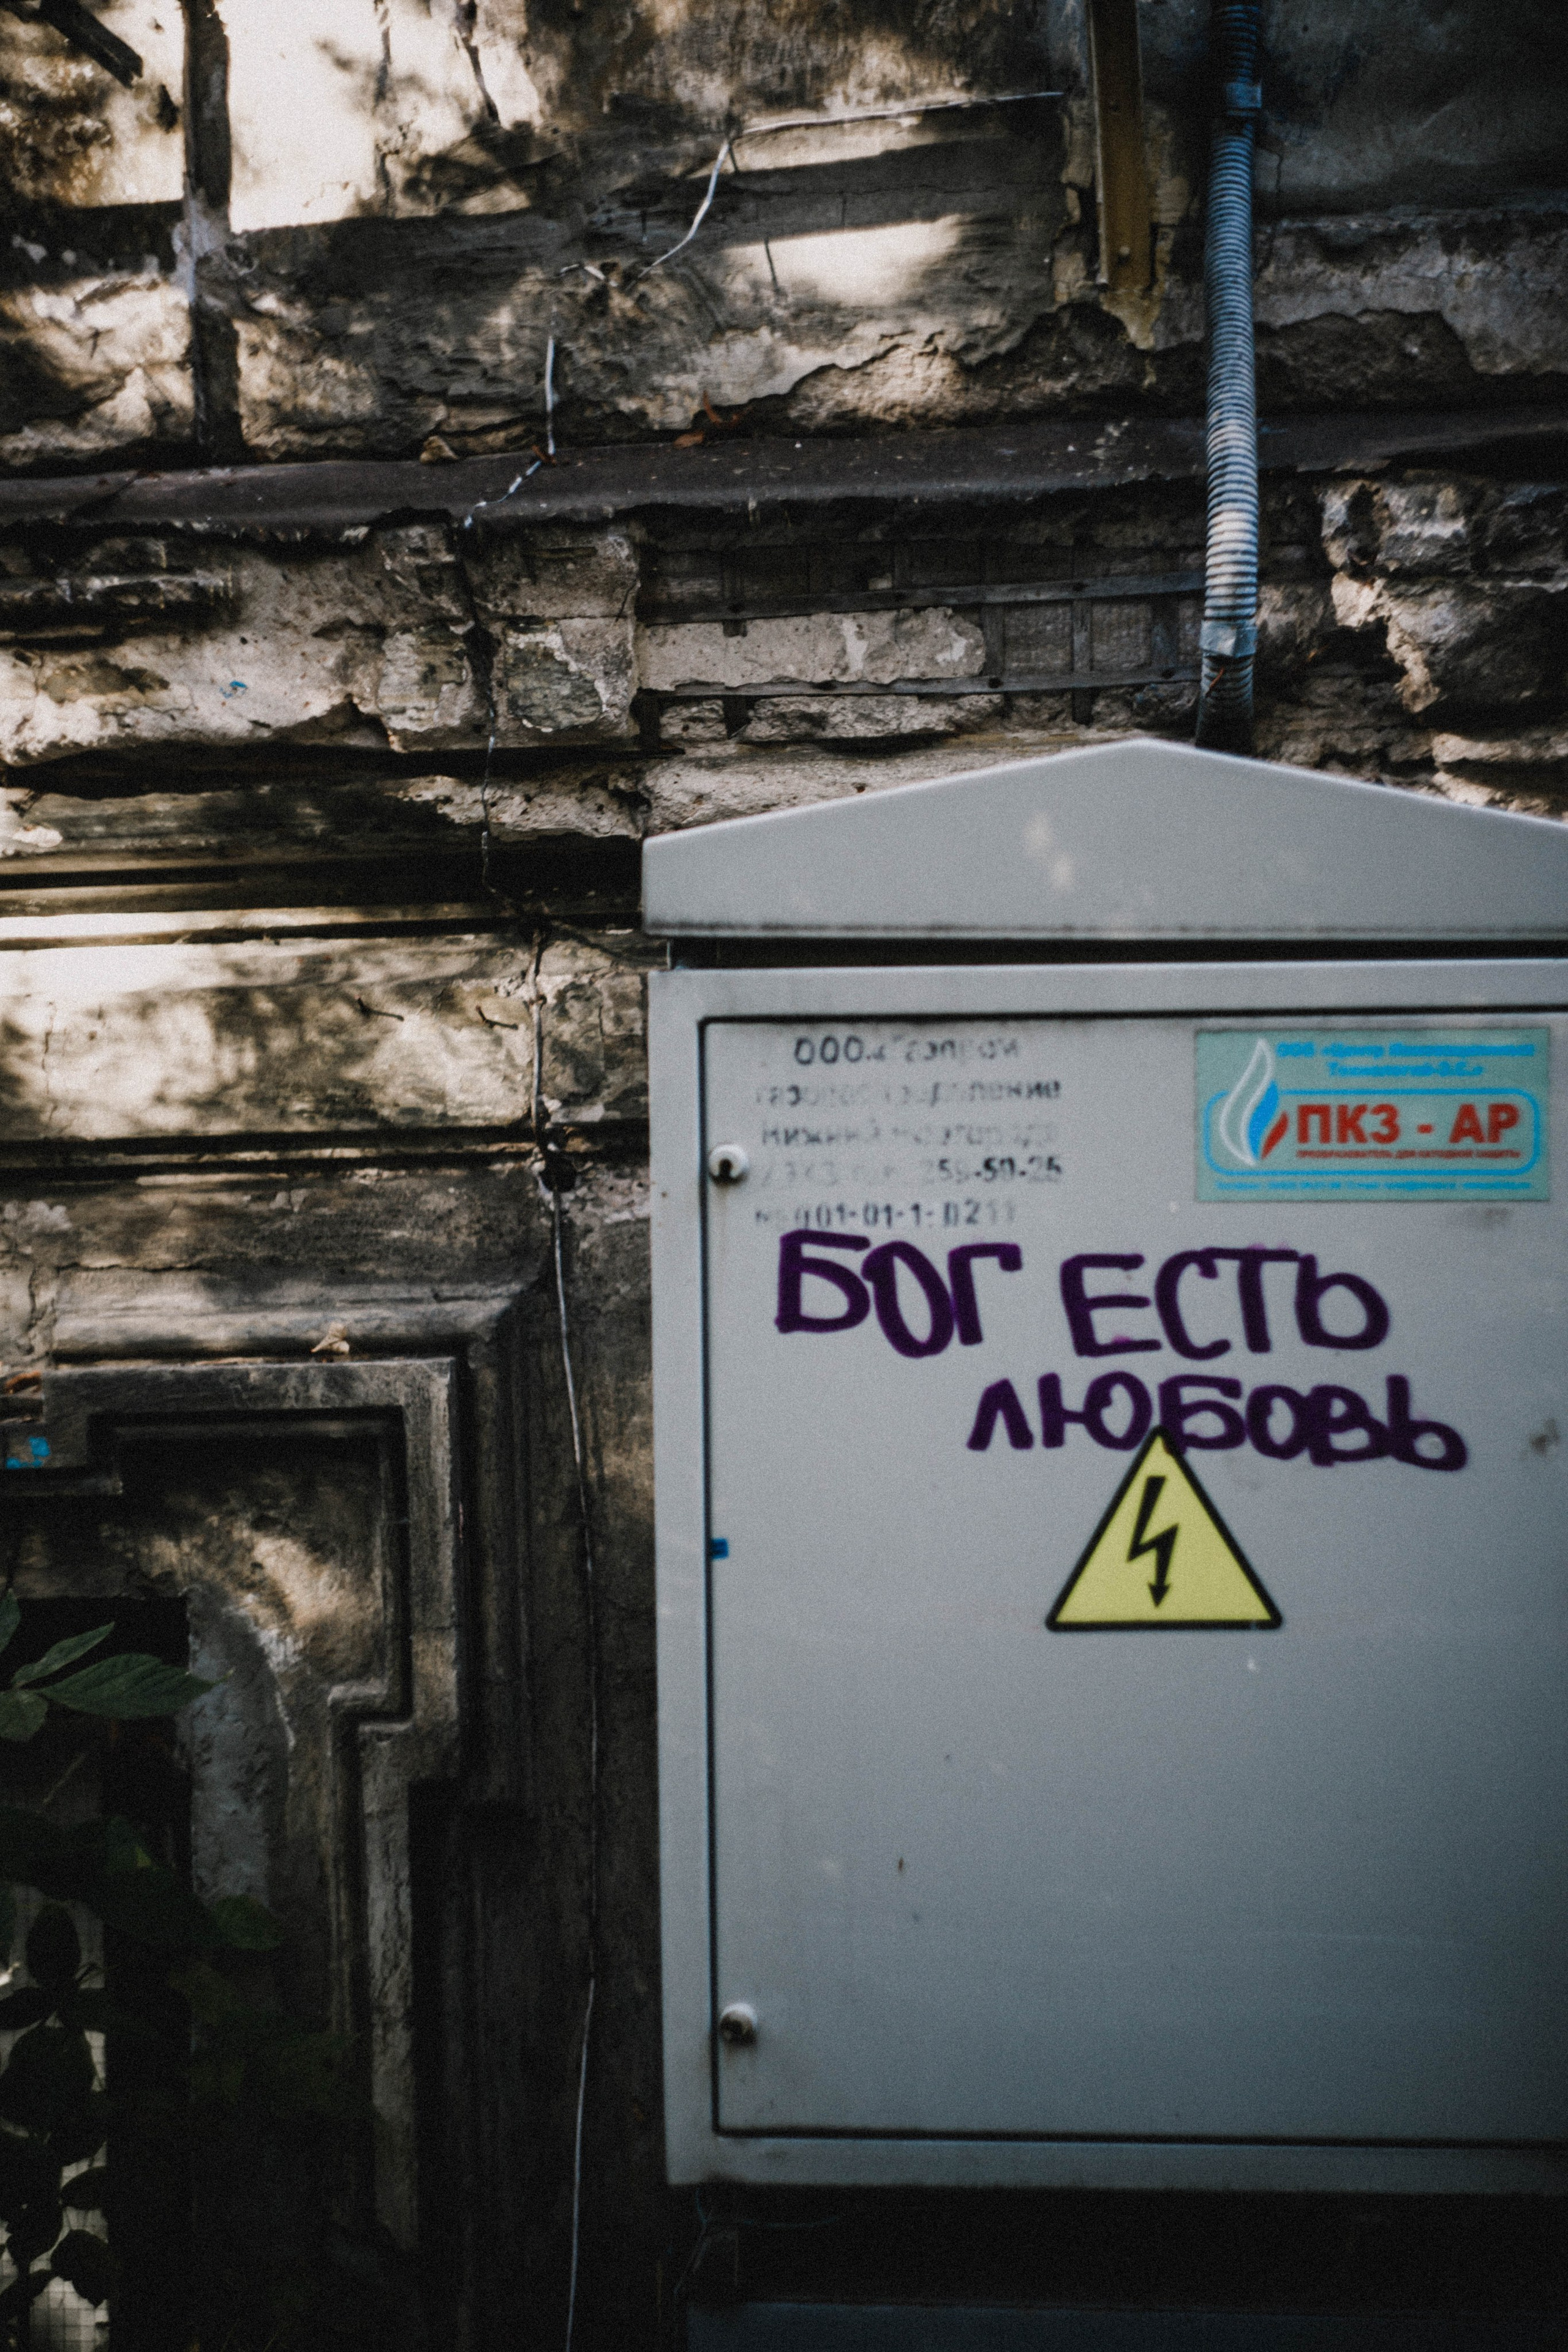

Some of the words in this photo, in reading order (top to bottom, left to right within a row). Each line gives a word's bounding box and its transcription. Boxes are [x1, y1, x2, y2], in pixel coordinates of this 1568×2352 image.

[1296, 1103, 1400, 1144] ПКЗ
[1449, 1103, 1520, 1144] АР
[774, 1230, 1022, 1358] БОГ
[1060, 1245, 1390, 1360] ЕСТЬ
[967, 1371, 1466, 1471] ЛЮБОВЬ
